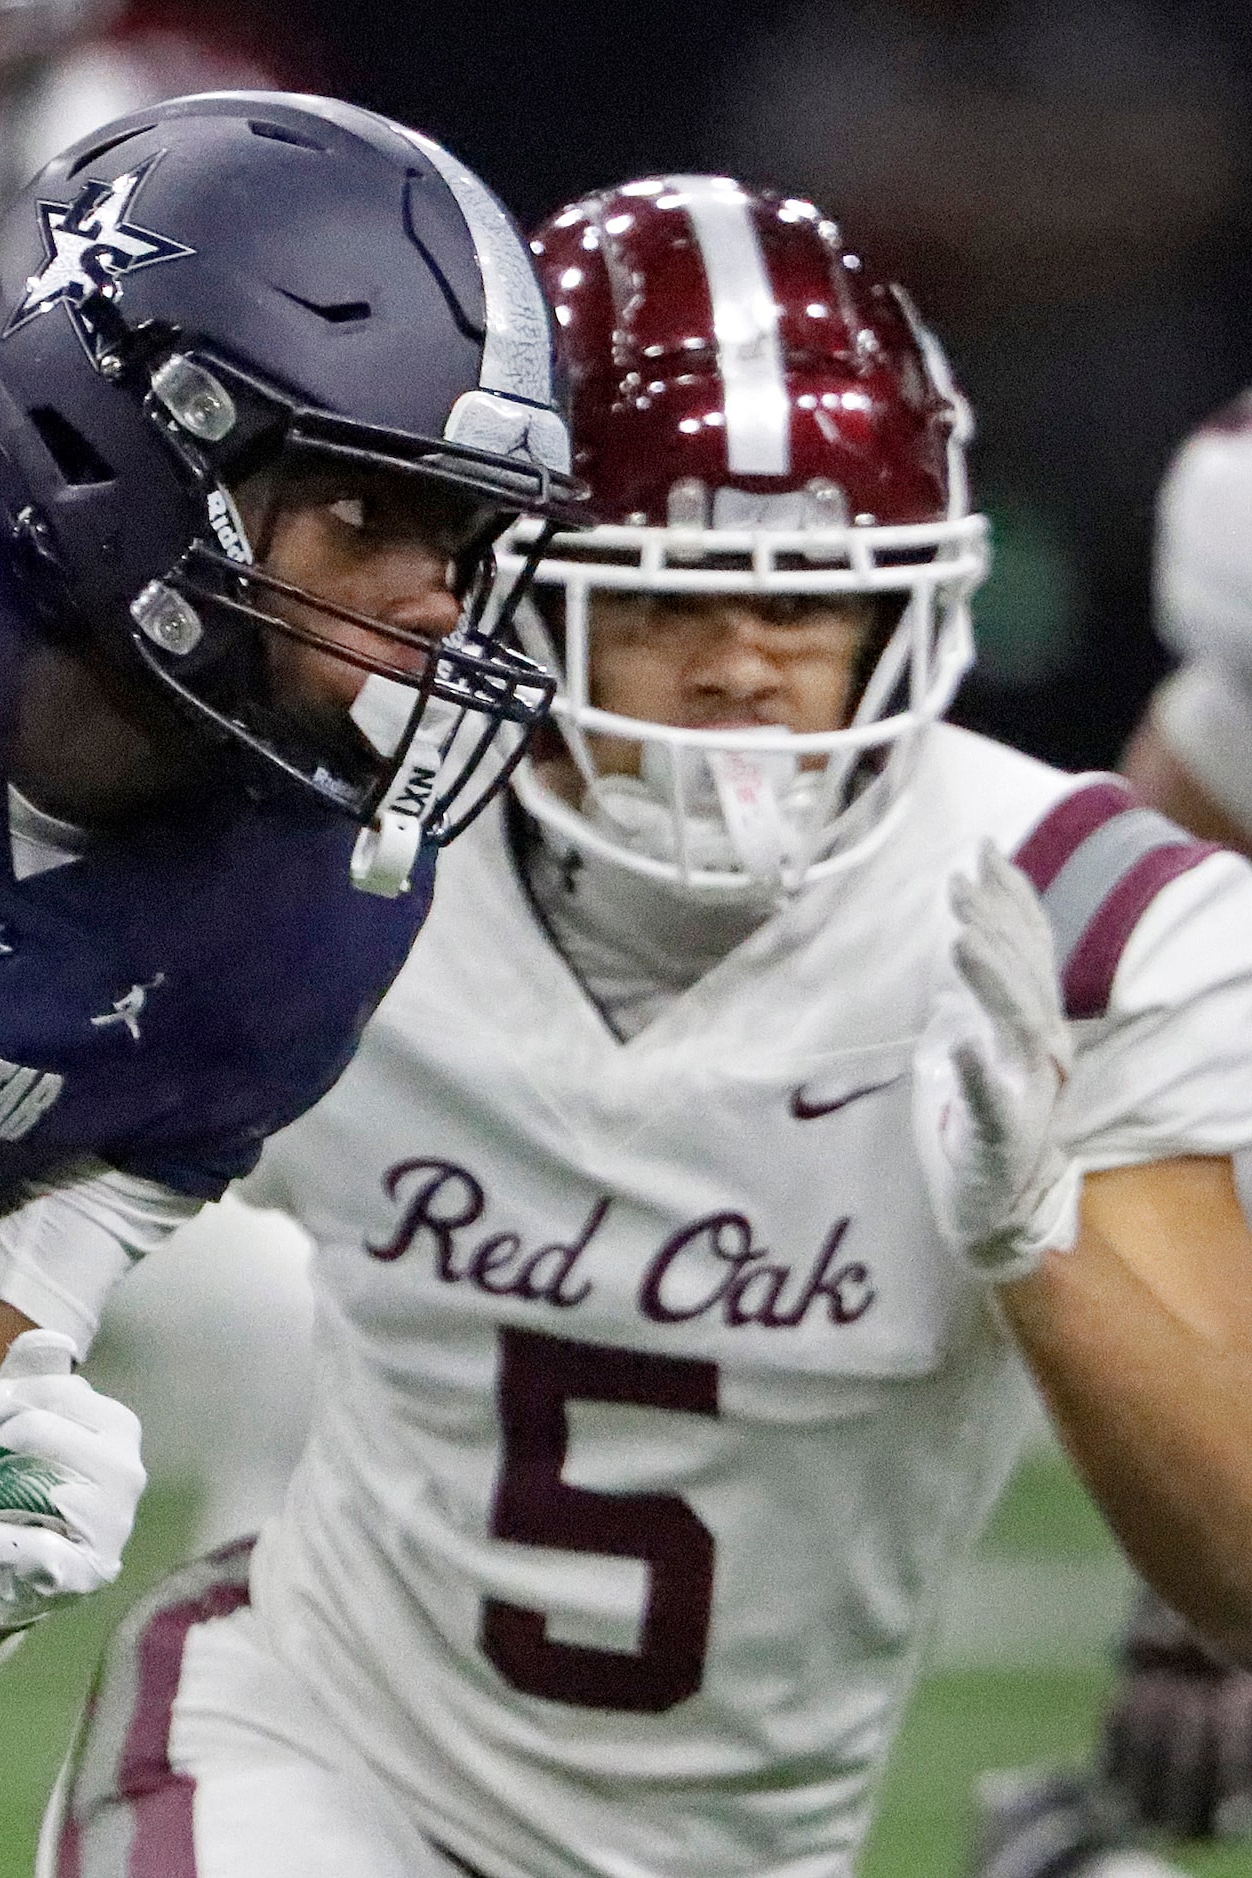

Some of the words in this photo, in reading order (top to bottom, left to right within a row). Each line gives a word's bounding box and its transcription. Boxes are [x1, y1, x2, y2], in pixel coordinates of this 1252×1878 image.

[364, 1157, 611, 1308] Red
[637, 1209, 877, 1328] Oak
[476, 1322, 720, 1716] 5
